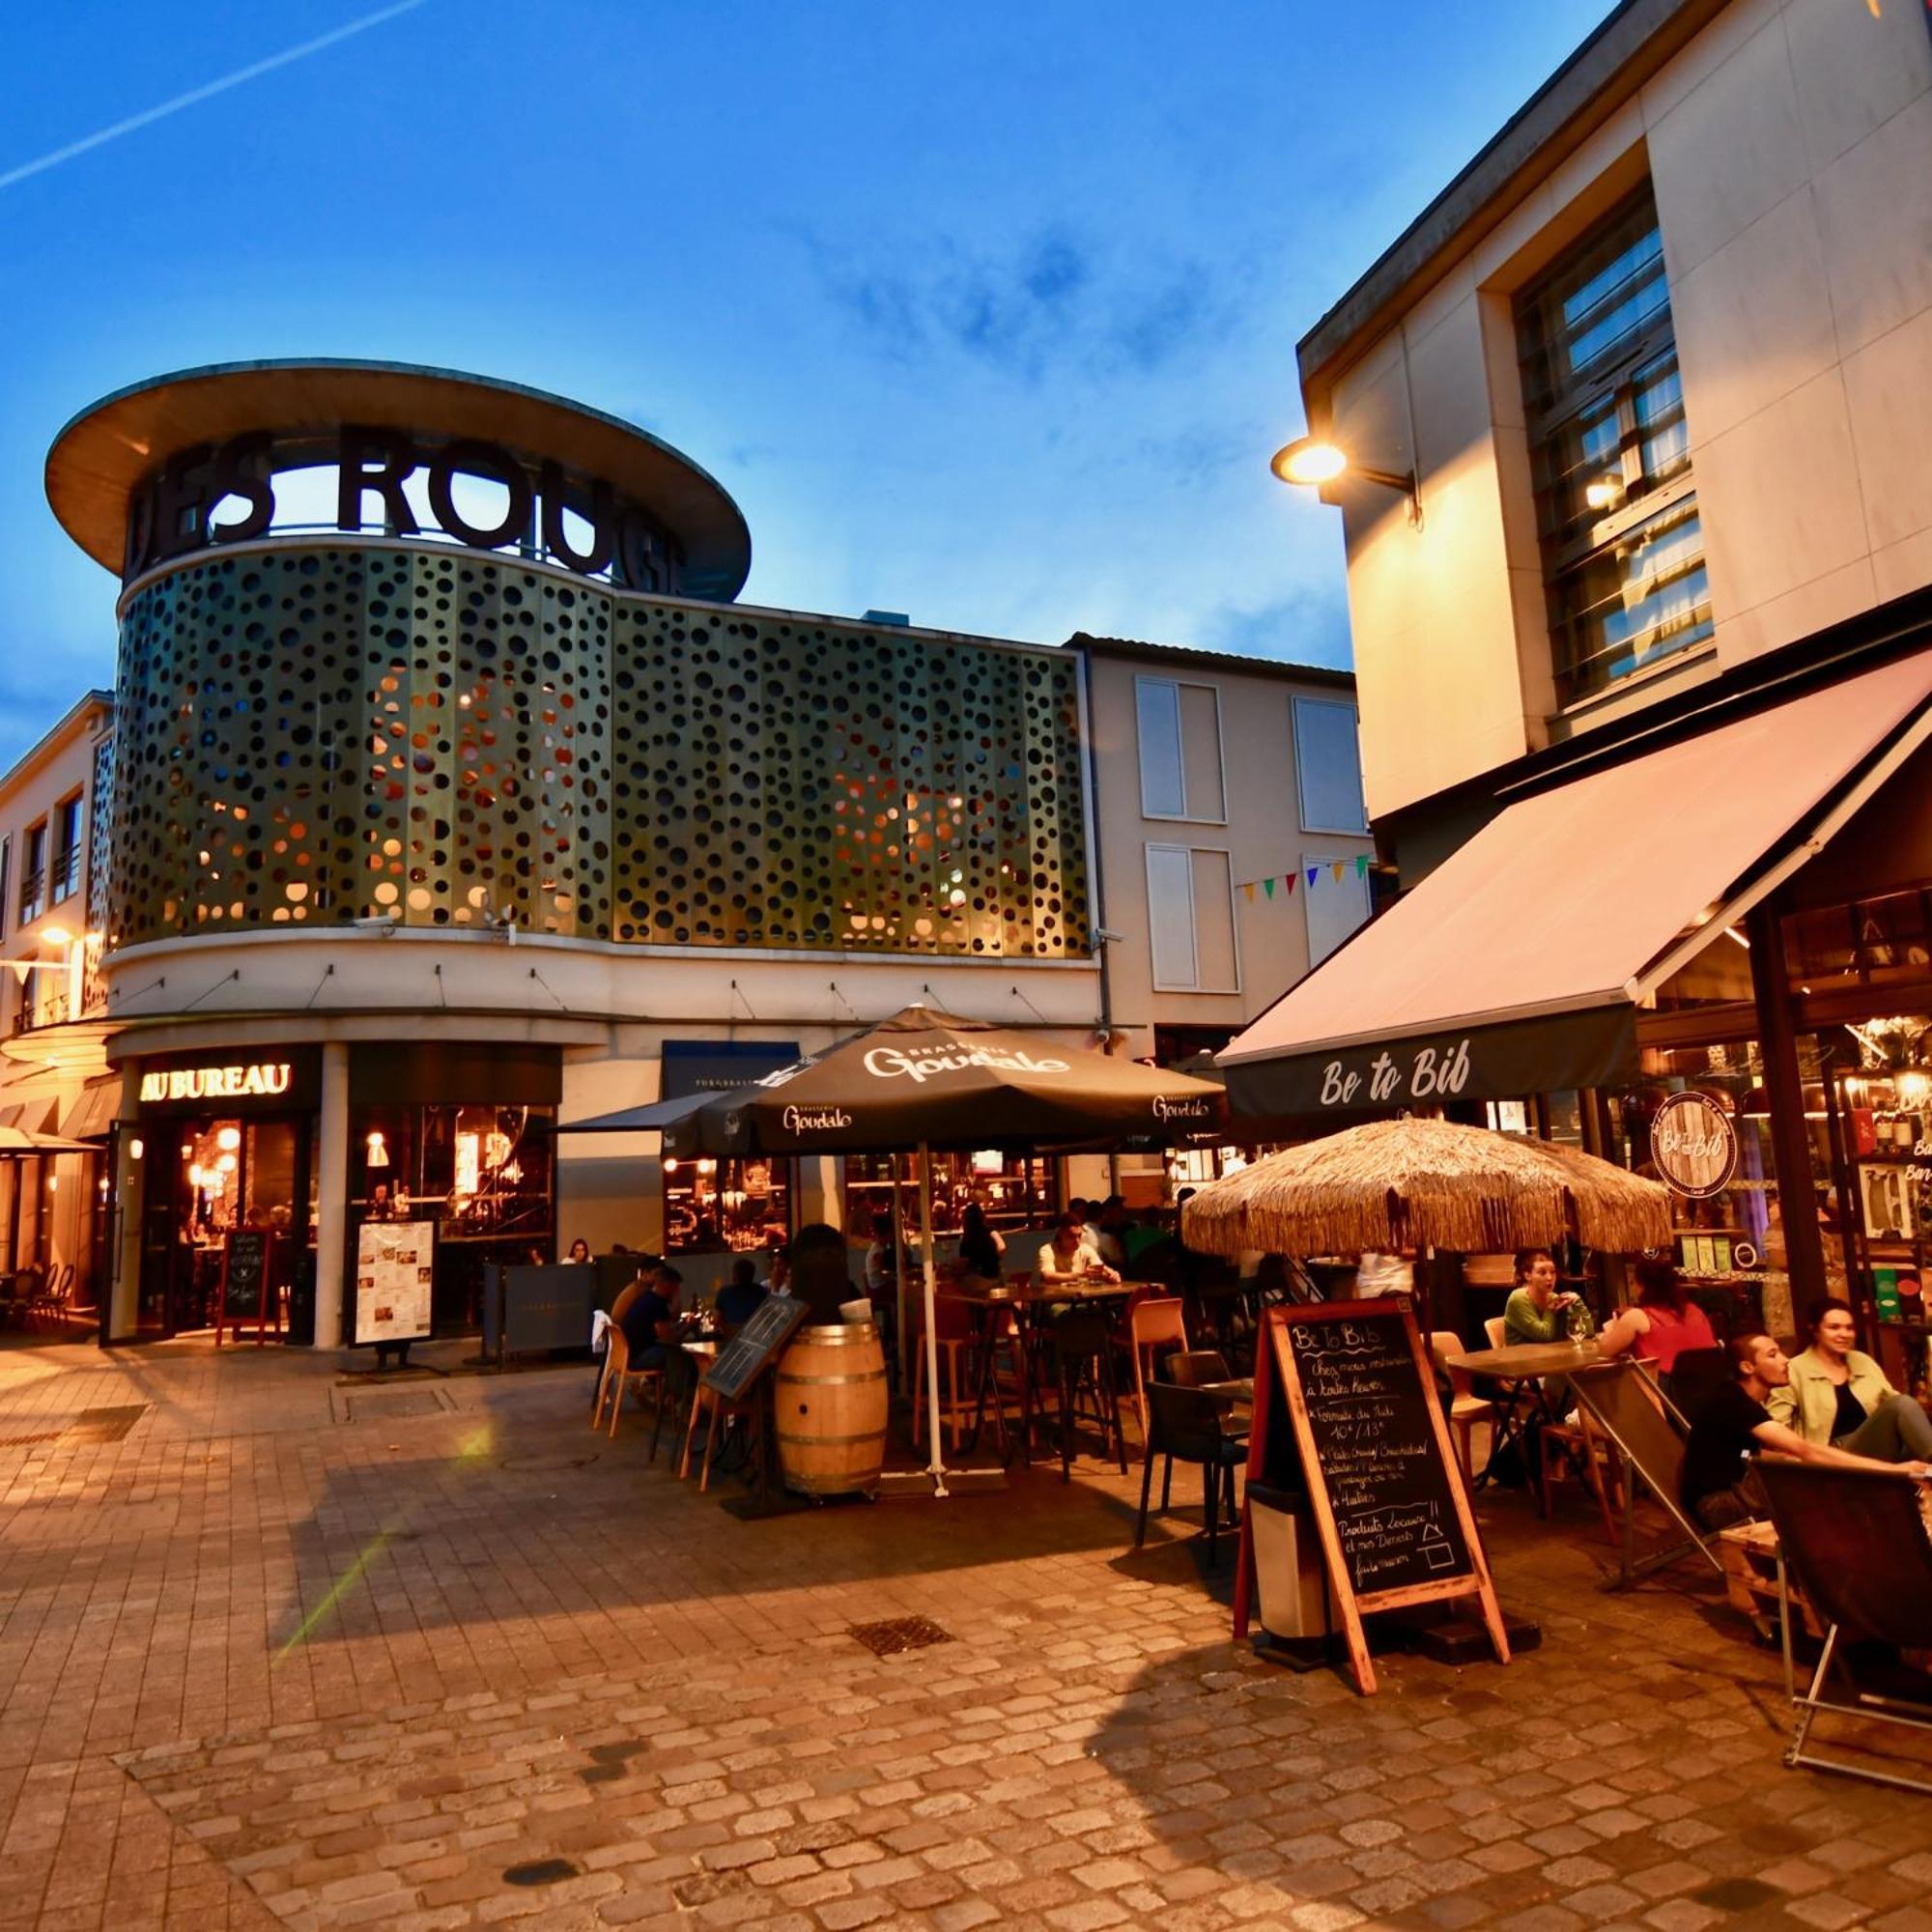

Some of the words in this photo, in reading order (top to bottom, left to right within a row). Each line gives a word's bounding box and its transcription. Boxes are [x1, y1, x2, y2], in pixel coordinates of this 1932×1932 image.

[864, 1047, 1071, 1083] Goudale
[1321, 1061, 1362, 1105] Be
[1370, 1051, 1402, 1101] to
[1410, 1038, 1470, 1097] Bib
[139, 1072, 169, 1101] AU
[169, 1064, 291, 1099] BUREAU
[783, 1105, 852, 1135] Goudale
[1152, 1094, 1209, 1123] Goudale
[1338, 1515, 1383, 1538] Produits
